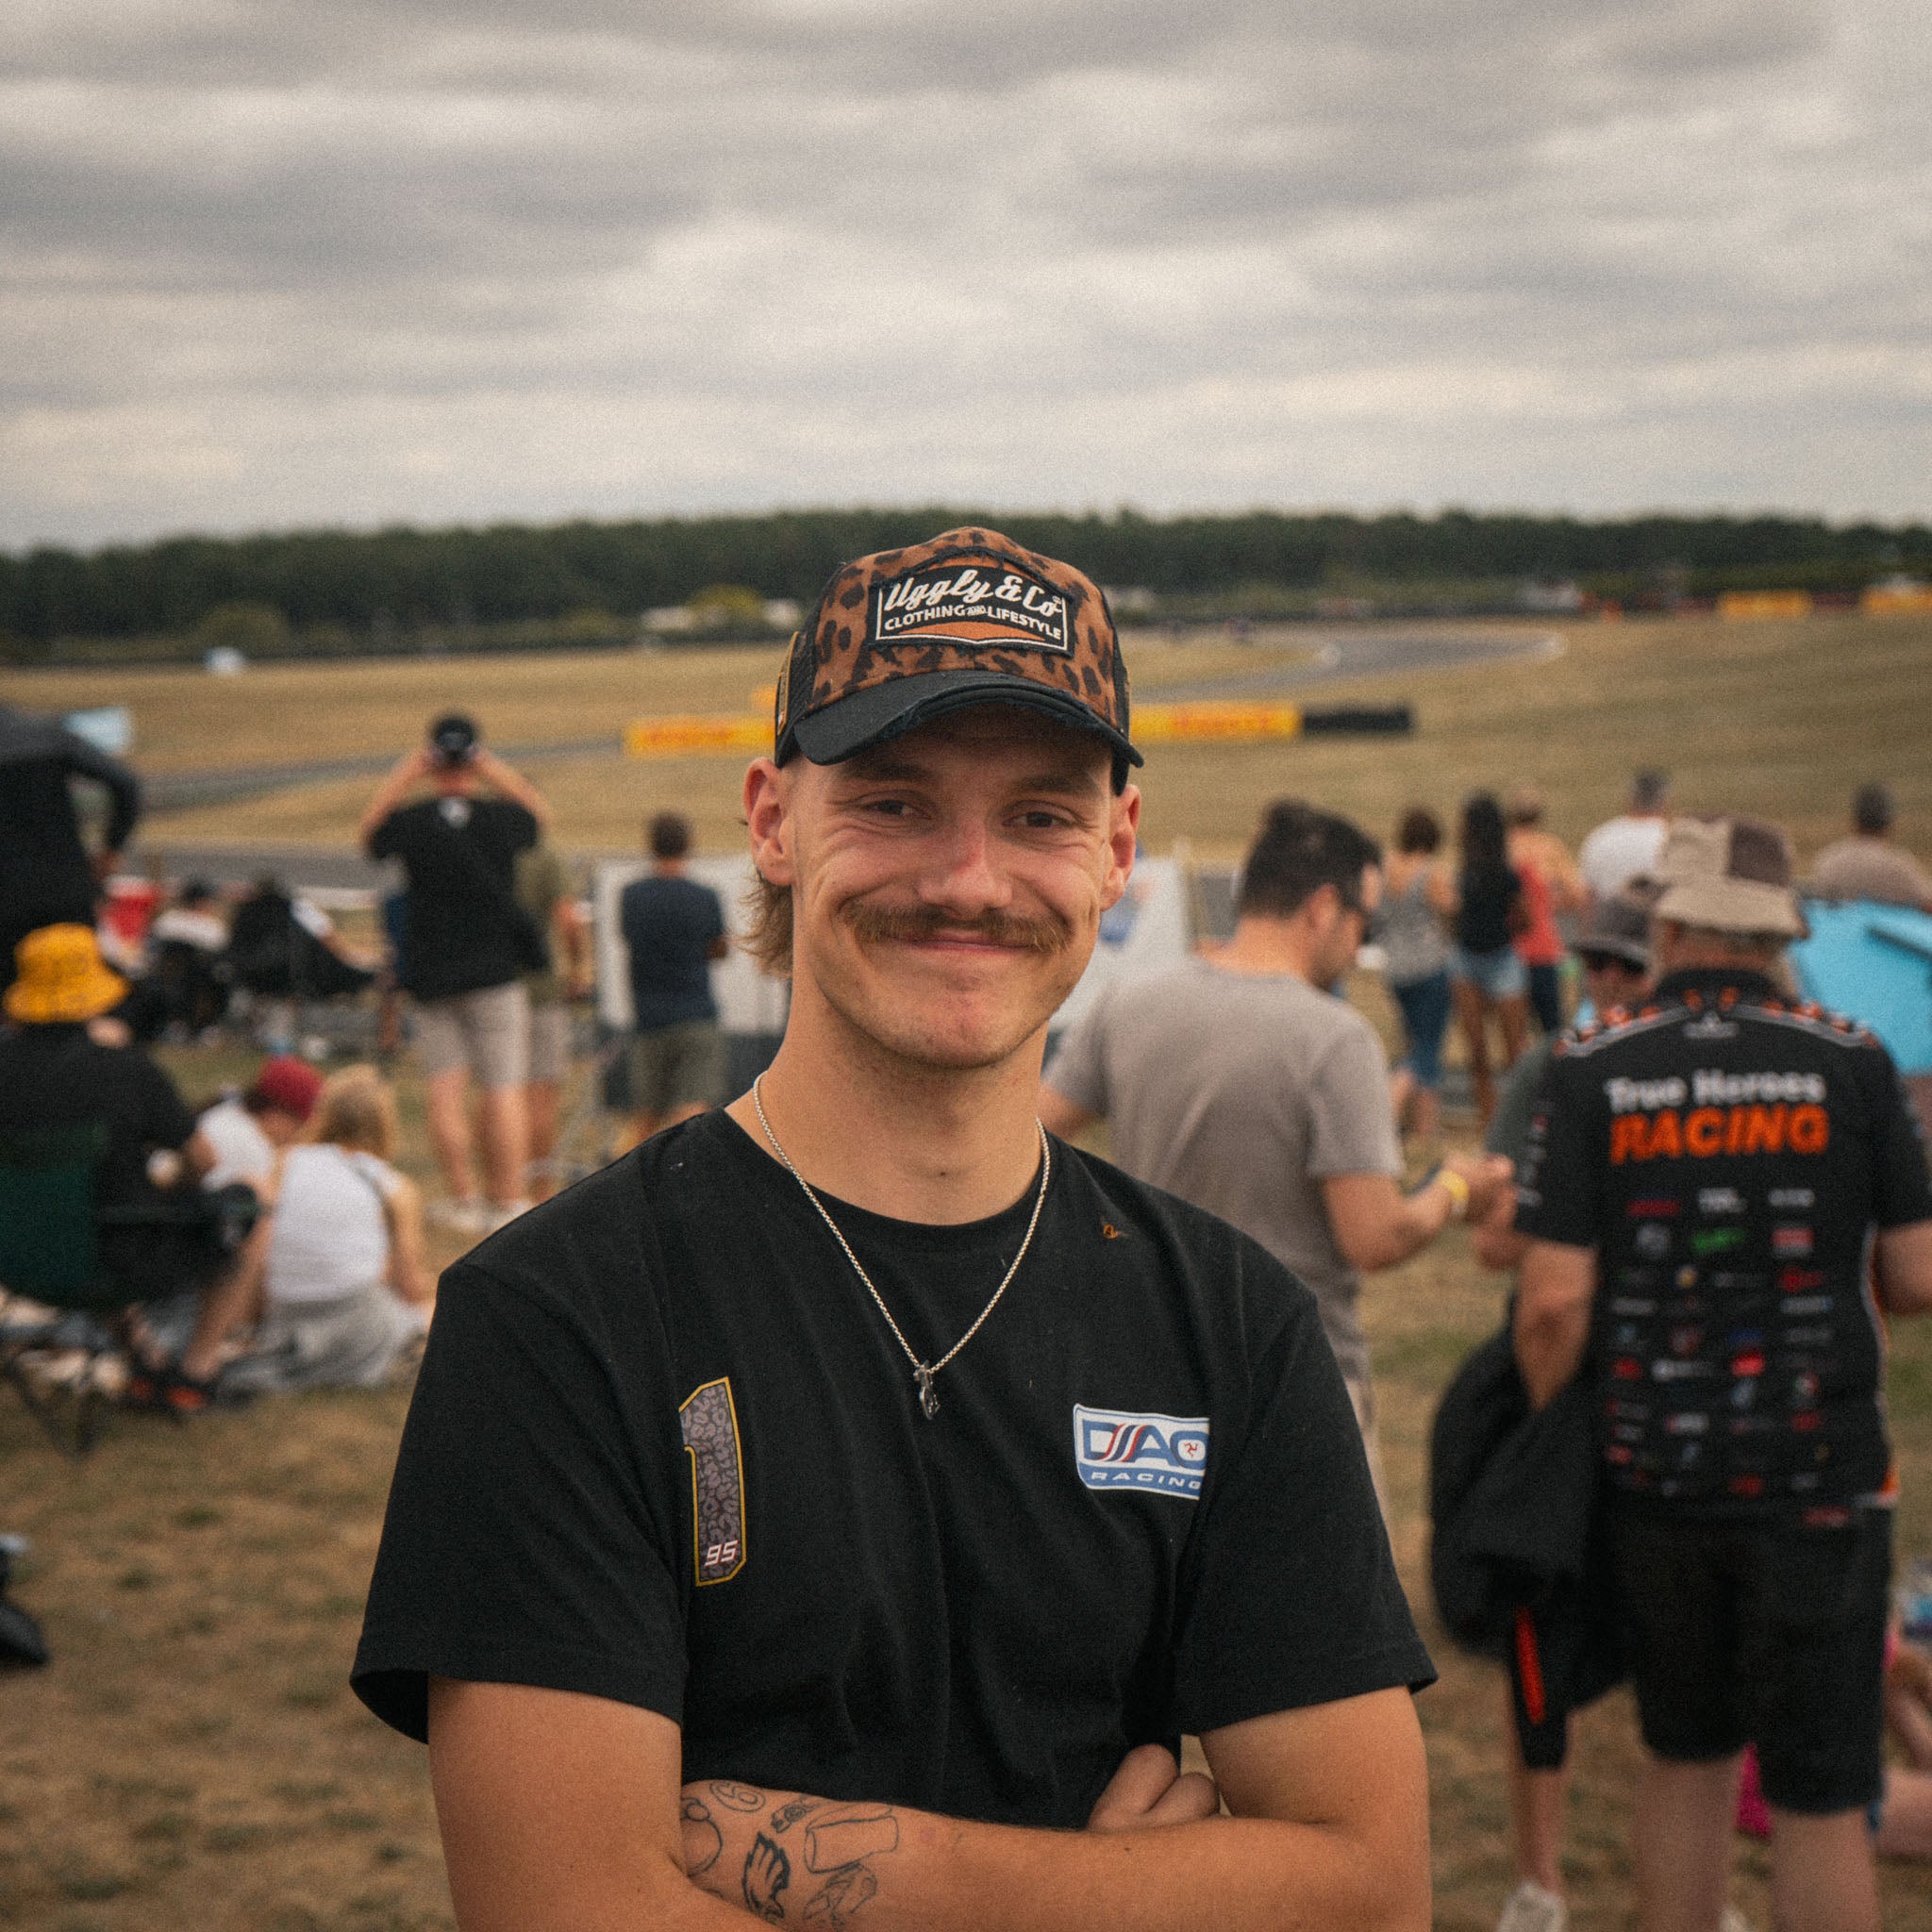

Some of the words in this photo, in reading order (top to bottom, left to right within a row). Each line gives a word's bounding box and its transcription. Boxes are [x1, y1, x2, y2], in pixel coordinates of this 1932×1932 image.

[884, 605, 965, 631] CLOTHING
[988, 606, 1061, 640] LIFESTYLE
[1607, 1076, 1687, 1113] True
[1692, 1069, 1826, 1105] Heroes
[1609, 1102, 1830, 1166] RACING
[1091, 1472, 1201, 1490] RACING
[704, 1541, 739, 1567] 95
